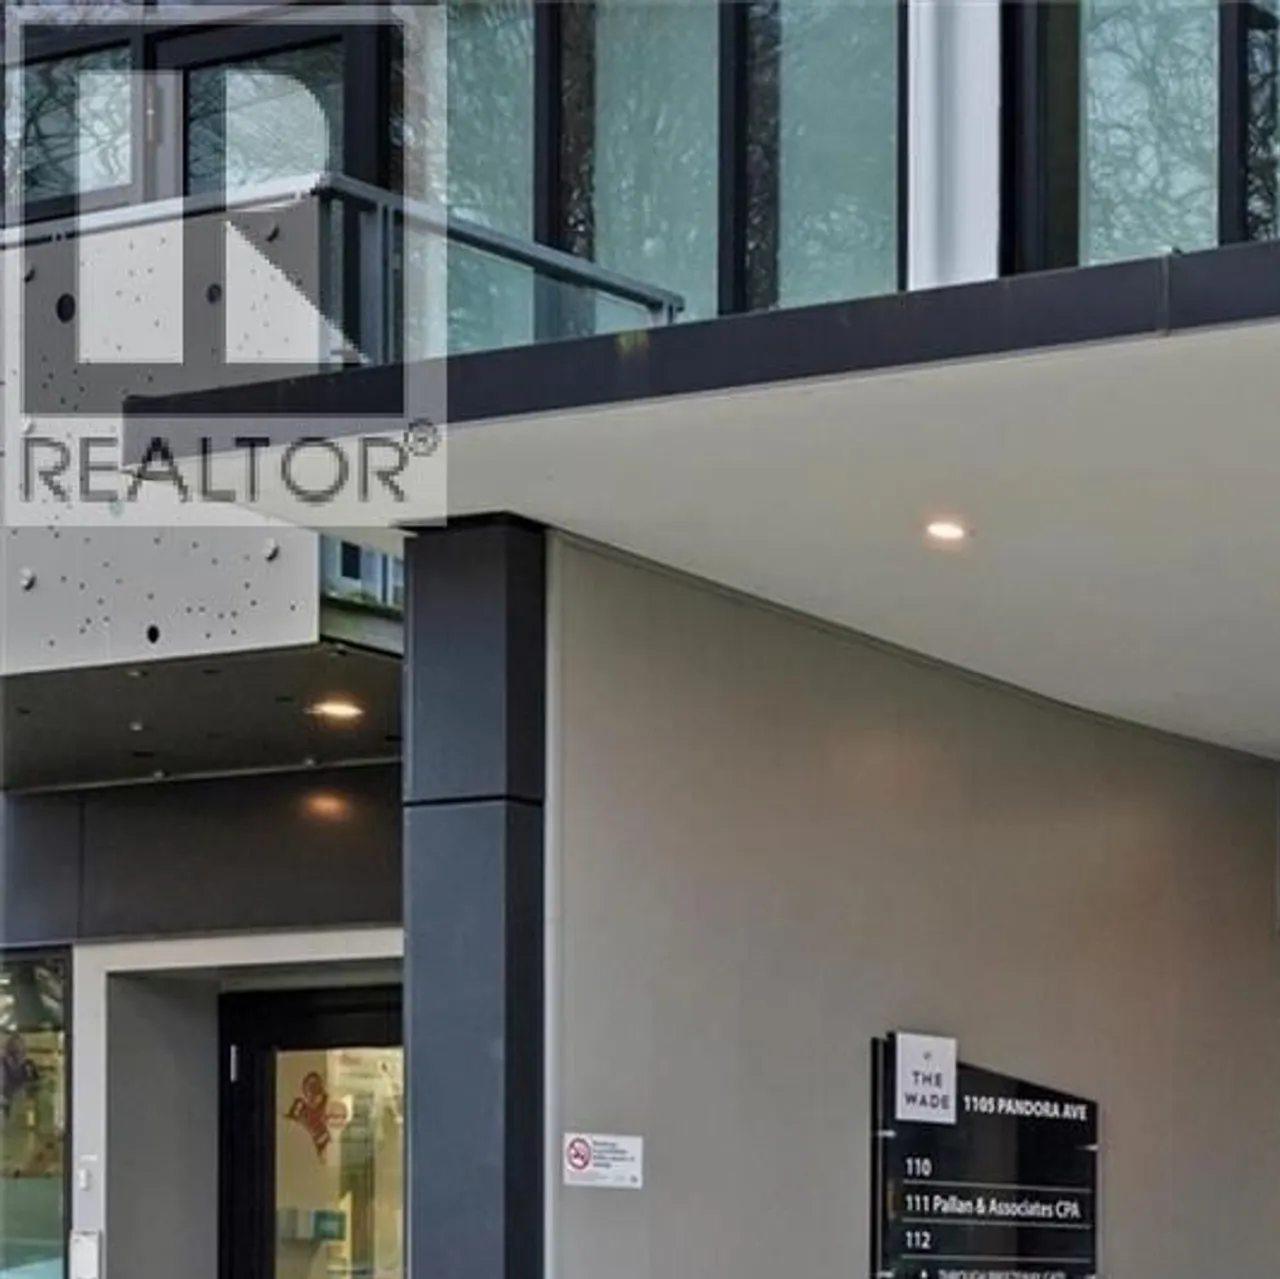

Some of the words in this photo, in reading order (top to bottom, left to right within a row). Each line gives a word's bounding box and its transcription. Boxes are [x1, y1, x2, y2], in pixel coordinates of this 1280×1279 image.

[911, 1070, 943, 1088] THE
[904, 1092, 951, 1110] WADE
[963, 1095, 995, 1114] 1105
[998, 1097, 1060, 1118] PANDORA
[1062, 1103, 1087, 1121] AVE
[905, 1157, 932, 1177] 110
[905, 1194, 930, 1212] 111
[976, 1197, 985, 1214] &
[988, 1198, 1053, 1218] Associates
[1055, 1200, 1081, 1219] CPA
[905, 1231, 932, 1249] 112
